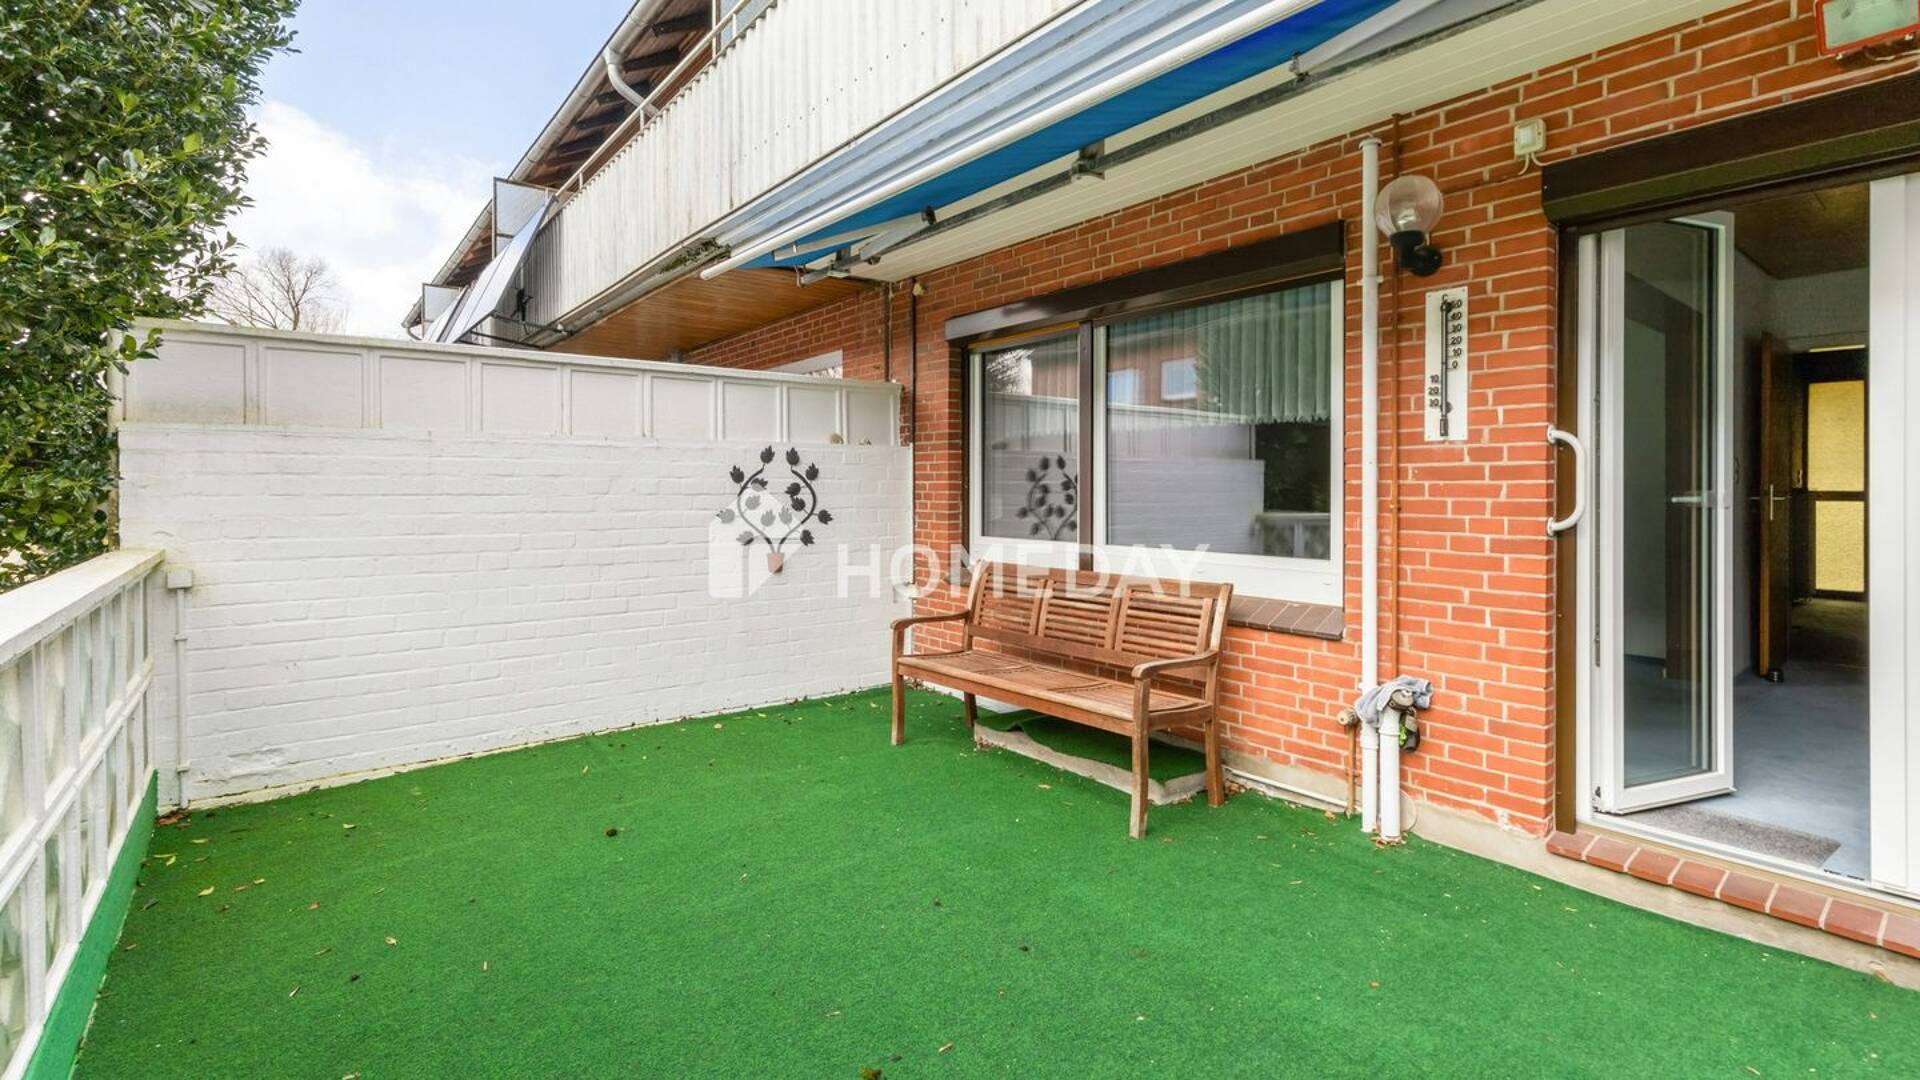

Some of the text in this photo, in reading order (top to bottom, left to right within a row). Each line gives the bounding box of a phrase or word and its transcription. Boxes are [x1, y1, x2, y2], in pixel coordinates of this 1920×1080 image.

[1450, 335, 1462, 346] 20
[1452, 347, 1462, 358] 10
[1451, 360, 1458, 369] 0
[1429, 374, 1440, 383] 10
[1428, 386, 1440, 396] 20
